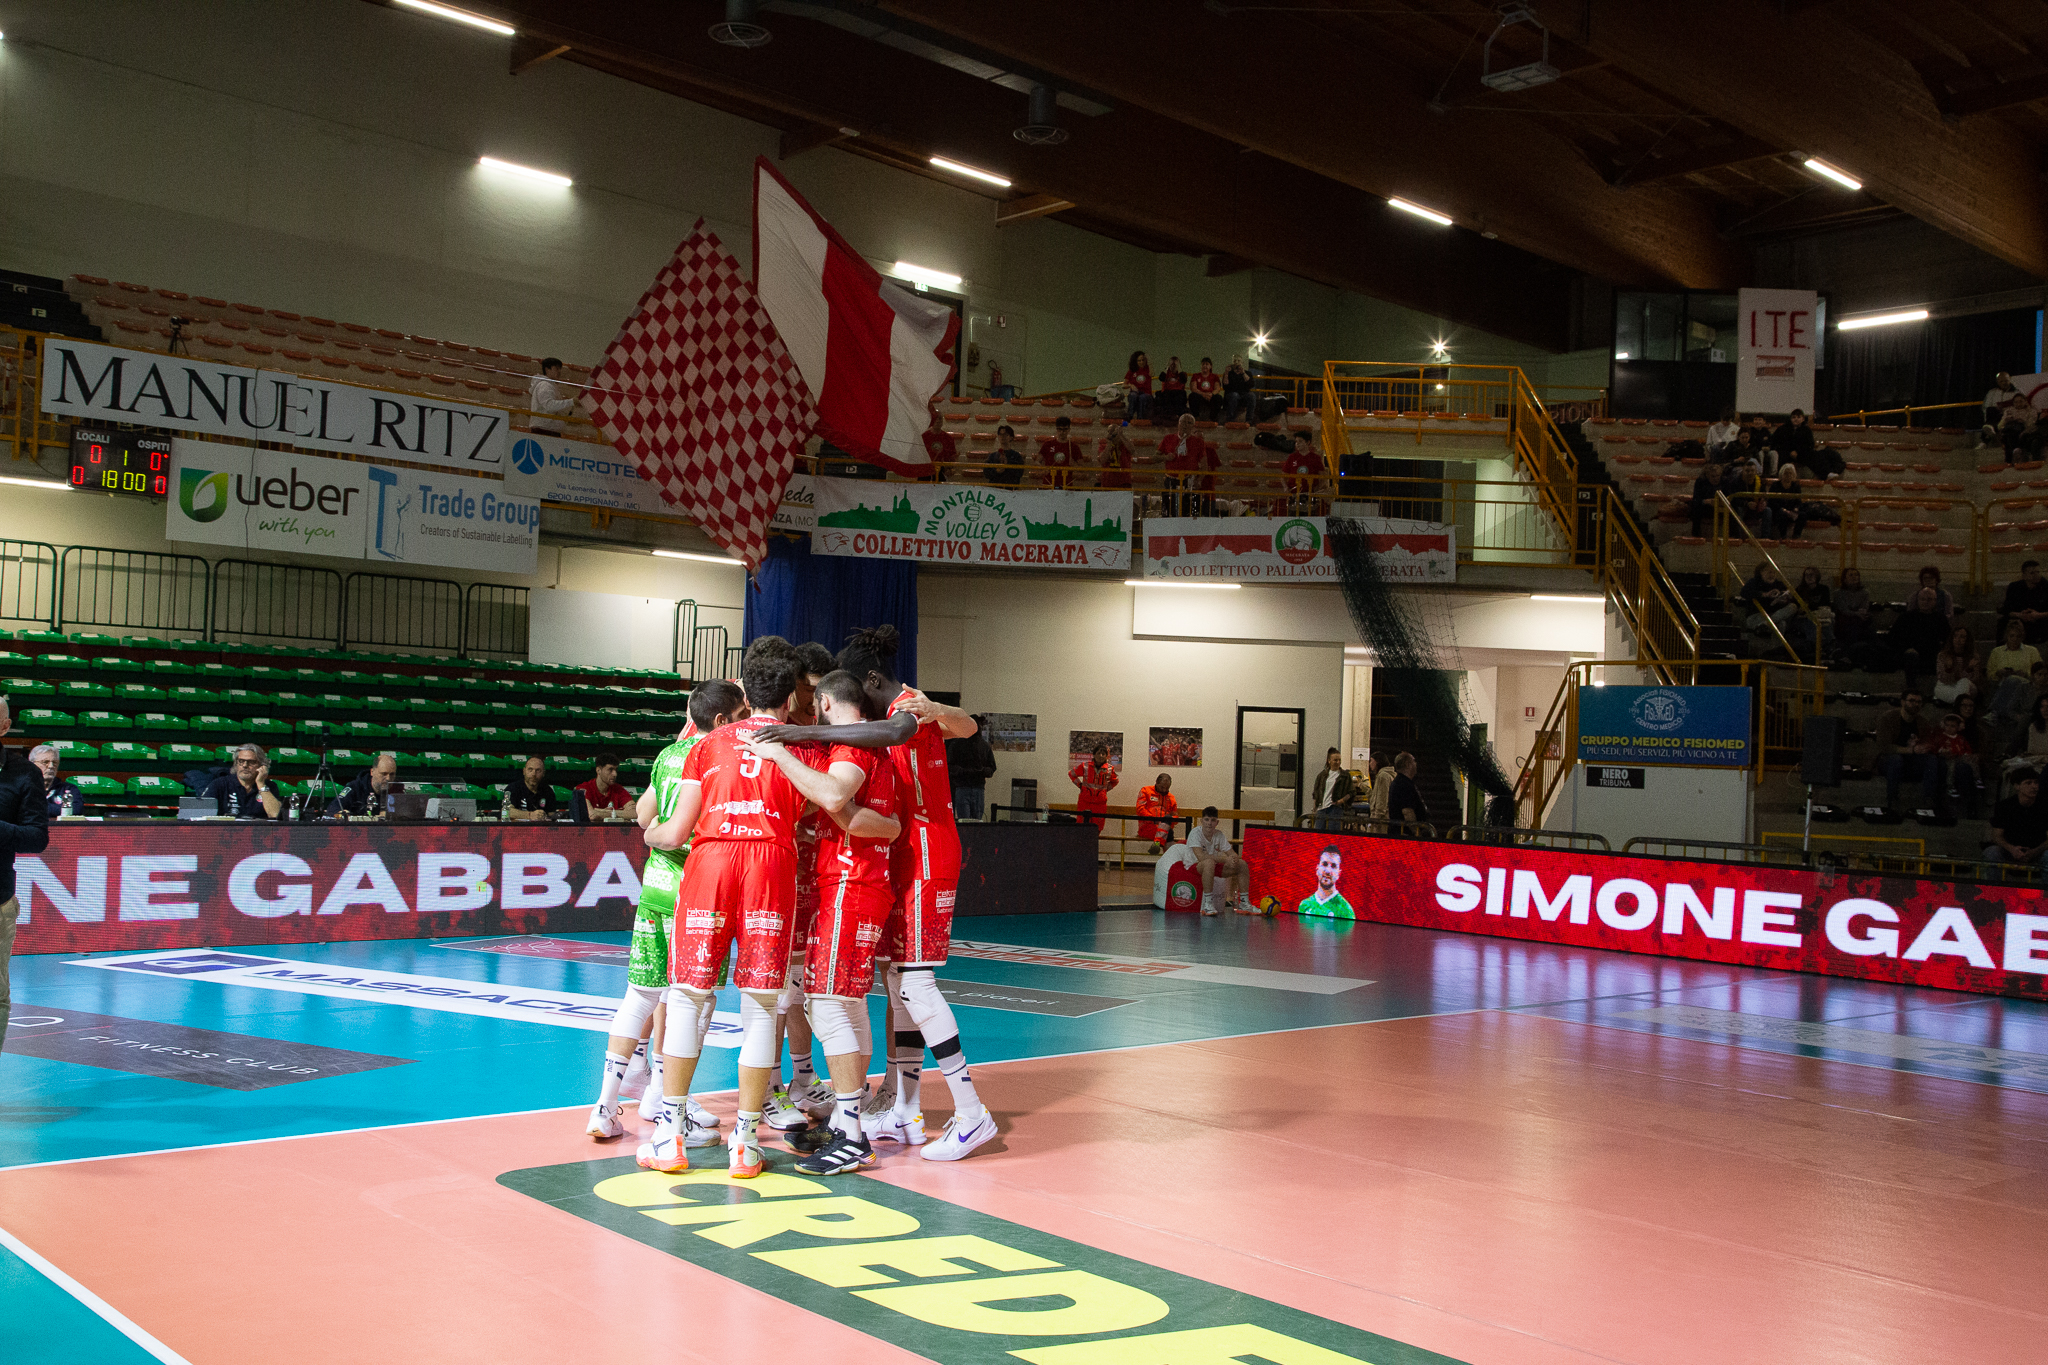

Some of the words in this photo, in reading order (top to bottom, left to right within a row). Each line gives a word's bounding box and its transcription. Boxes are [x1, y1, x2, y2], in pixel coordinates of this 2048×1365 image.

[51, 348, 355, 443] MANUEL
[366, 397, 502, 464] RITZ
[76, 431, 110, 444] LOCALI
[138, 439, 170, 452] OSPITI
[90, 444, 102, 464] 0
[150, 452, 162, 471] 0
[72, 466, 84, 485] 0
[154, 475, 166, 494] 0
[235, 467, 359, 516] ueber
[418, 484, 476, 520] Trade
[481, 492, 540, 534] Group
[574, 495, 619, 507] APPIGNANO
[924, 490, 1020, 540] MONTALBANO
[258, 516, 299, 536] with
[304, 526, 336, 545] you
[420, 523, 451, 538] Creators
[452, 526, 460, 539] of
[461, 528, 501, 544] Sustainable
[502, 532, 533, 548] Labelling
[945, 522, 1001, 541] VOLLEY
[852, 533, 972, 561] COLLETTIVO
[979, 541, 1089, 566] MACERATA
[1172, 564, 1262, 577] COLLETTIVO
[1580, 735, 1630, 746] GRUPPO
[1632, 736, 1681, 748] MEDICO
[1683, 737, 1745, 750] FISIOMED
[1686, 749, 1717, 759] VICINO
[1726, 751, 1738, 760] TE
[740, 751, 762, 778] 5
[1602, 768, 1629, 780] NERO
[1599, 778, 1632, 788] TRIBUNA
[660, 776, 682, 818] 17
[732, 824, 763, 837] iPro
[227, 852, 643, 917] GABBA
[1435, 862, 1803, 948] SIMONE
[959, 992, 1060, 1005] piaceri
[79, 1034, 219, 1060] FITNESS
[226, 1057, 320, 1076] CLUB
